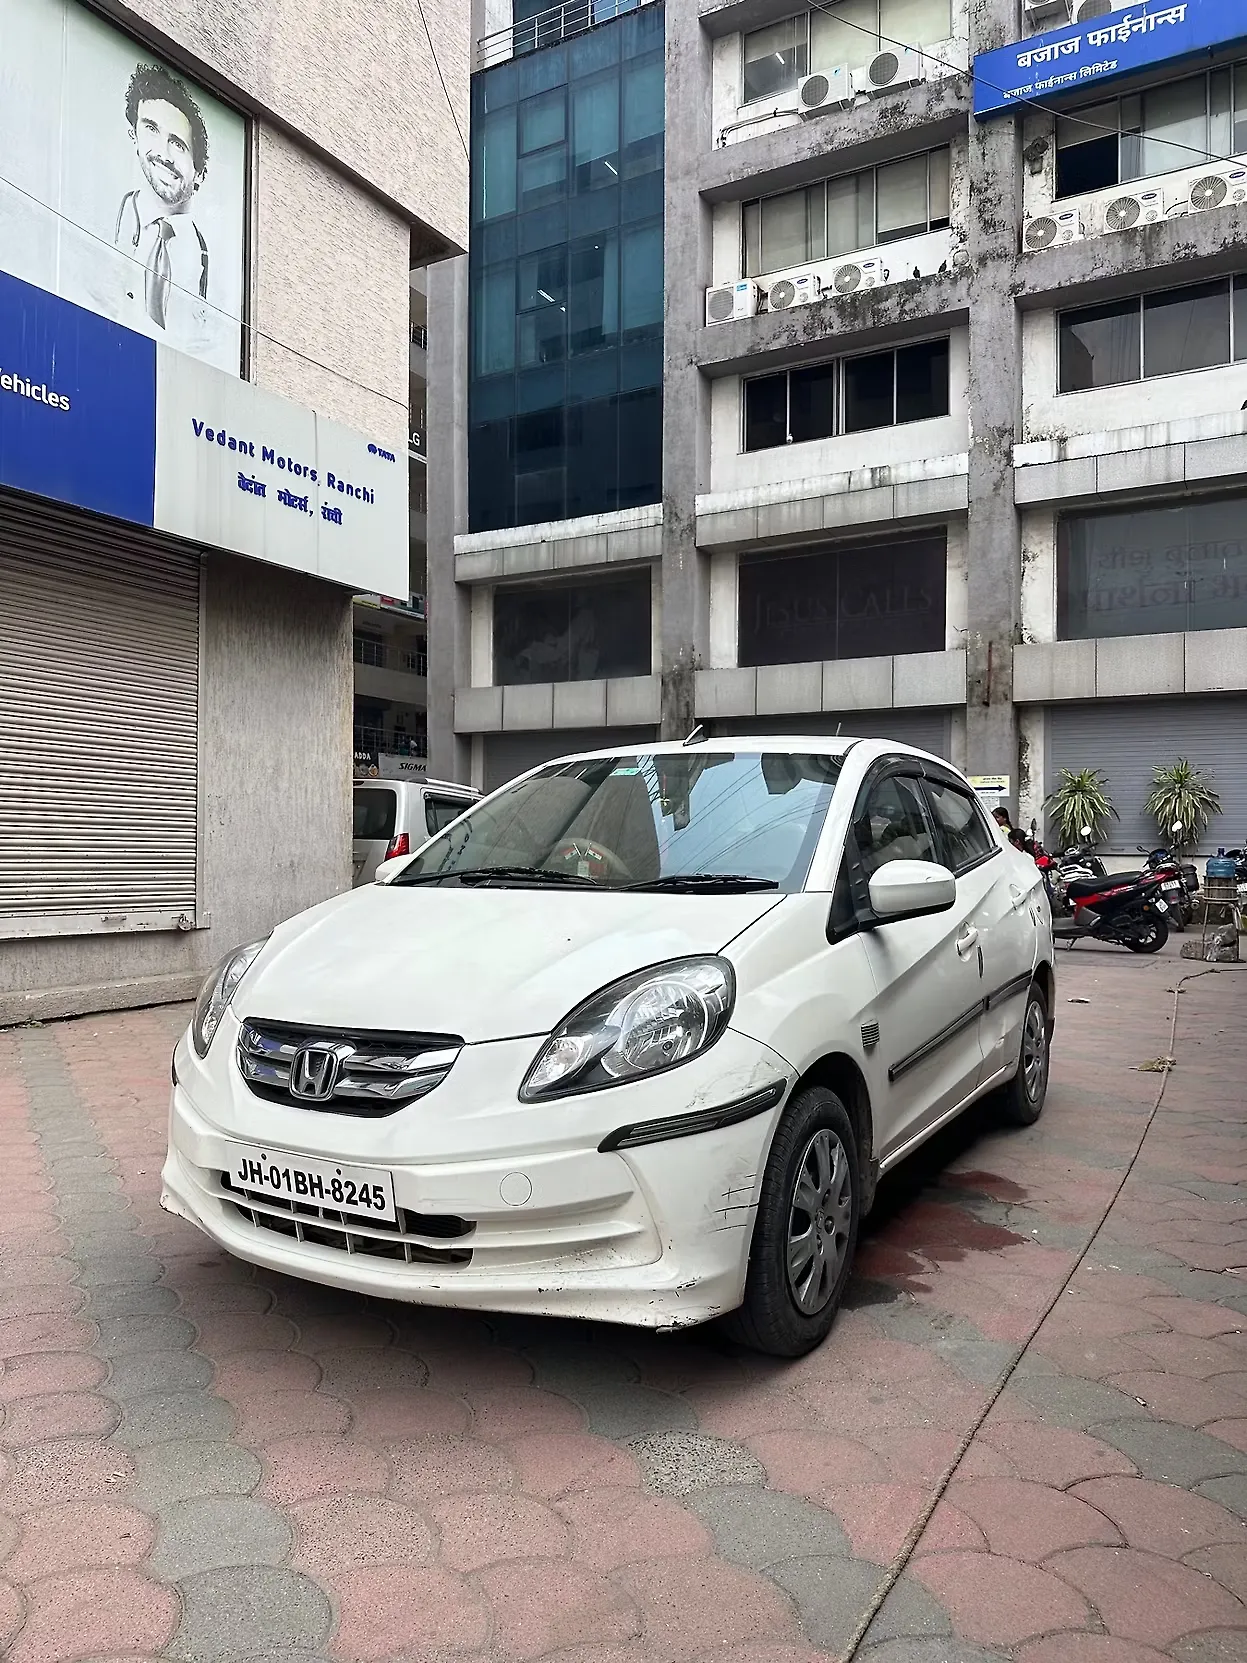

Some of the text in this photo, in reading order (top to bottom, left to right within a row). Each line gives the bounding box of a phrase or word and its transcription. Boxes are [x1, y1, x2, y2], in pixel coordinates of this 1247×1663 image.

[1016, 2, 1188, 69] बजाज फाईनान्स
[0, 367, 71, 411] ehicles
[192, 417, 256, 458] Vedant
[327, 471, 375, 505] Ranchi
[377, 447, 396, 463] TATA
[399, 762, 427, 772] SIGMA
[238, 1158, 386, 1211] JH-01BH-8245
